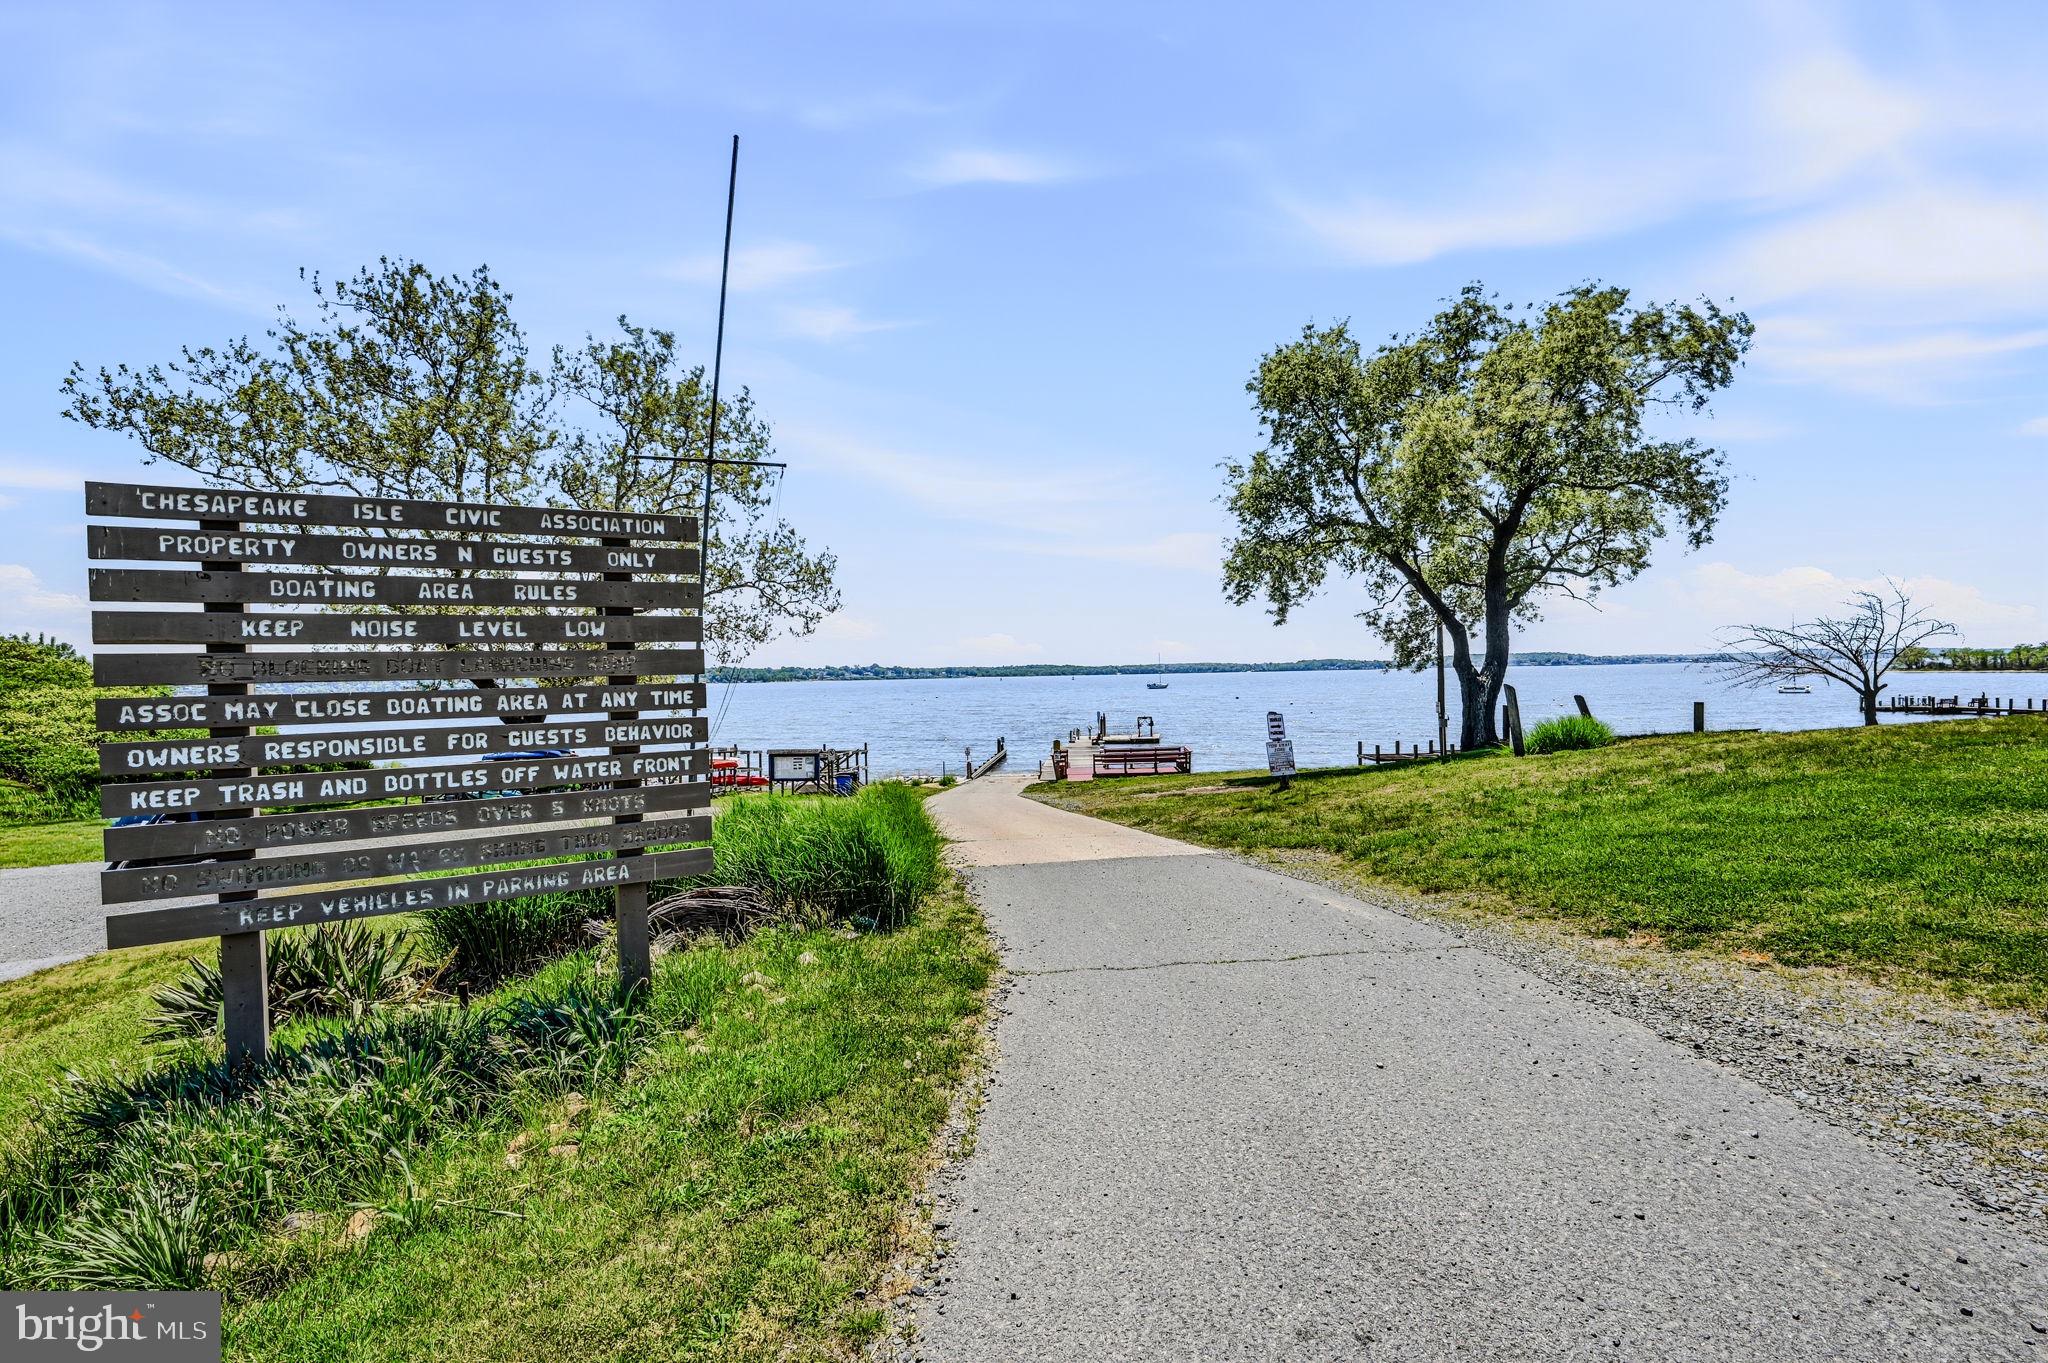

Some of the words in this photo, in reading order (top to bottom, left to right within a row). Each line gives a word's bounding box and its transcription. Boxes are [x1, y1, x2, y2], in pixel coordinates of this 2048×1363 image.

[141, 491, 308, 517] CHESAPEAKE
[353, 503, 403, 522] ISLE
[446, 508, 501, 526] CIVIC
[540, 513, 666, 535] ASSOCIATION
[159, 535, 296, 557] PROPERTY
[342, 542, 437, 561] OWNERS
[458, 547, 473, 562] N
[493, 548, 572, 566] GUESTS
[607, 552, 656, 568] ONLY
[270, 576, 375, 598] BOATING
[418, 583, 474, 600] AREA
[514, 584, 577, 601] RULES
[241, 619, 304, 637] KEEP
[351, 620, 418, 637] NOISE
[459, 620, 528, 638] LEVEL
[565, 621, 606, 637] LOW
[119, 703, 207, 724] ASSOC
[224, 701, 278, 720] MAY
[295, 699, 371, 717] CLOSE
[387, 696, 483, 715] BOATING
[497, 694, 548, 712] AREA
[562, 693, 588, 709] AT
[601, 691, 638, 708] ANY
[650, 689, 694, 705] TIME
[127, 744, 240, 767] OWNERS
[264, 735, 426, 760] RESPONSIBLE
[448, 732, 488, 749] FOR
[508, 728, 587, 746] GUESTS
[605, 723, 693, 742] BEHAVIOR
[131, 787, 201, 809] KEEP
[219, 781, 304, 803] TRASH
[320, 777, 367, 797] AND
[384, 770, 488, 792] BOTTLES
[501, 766, 540, 784] OFF
[553, 759, 622, 780] WATER
[633, 756, 693, 774] FRONT
[264, 817, 348, 841] POWER
[477, 803, 533, 823] OVER
[240, 904, 303, 927] KEEP
[320, 888, 433, 914] VEHICLES
[448, 882, 469, 901] IN
[483, 870, 569, 897] PARKING
[582, 864, 630, 884] AREA
